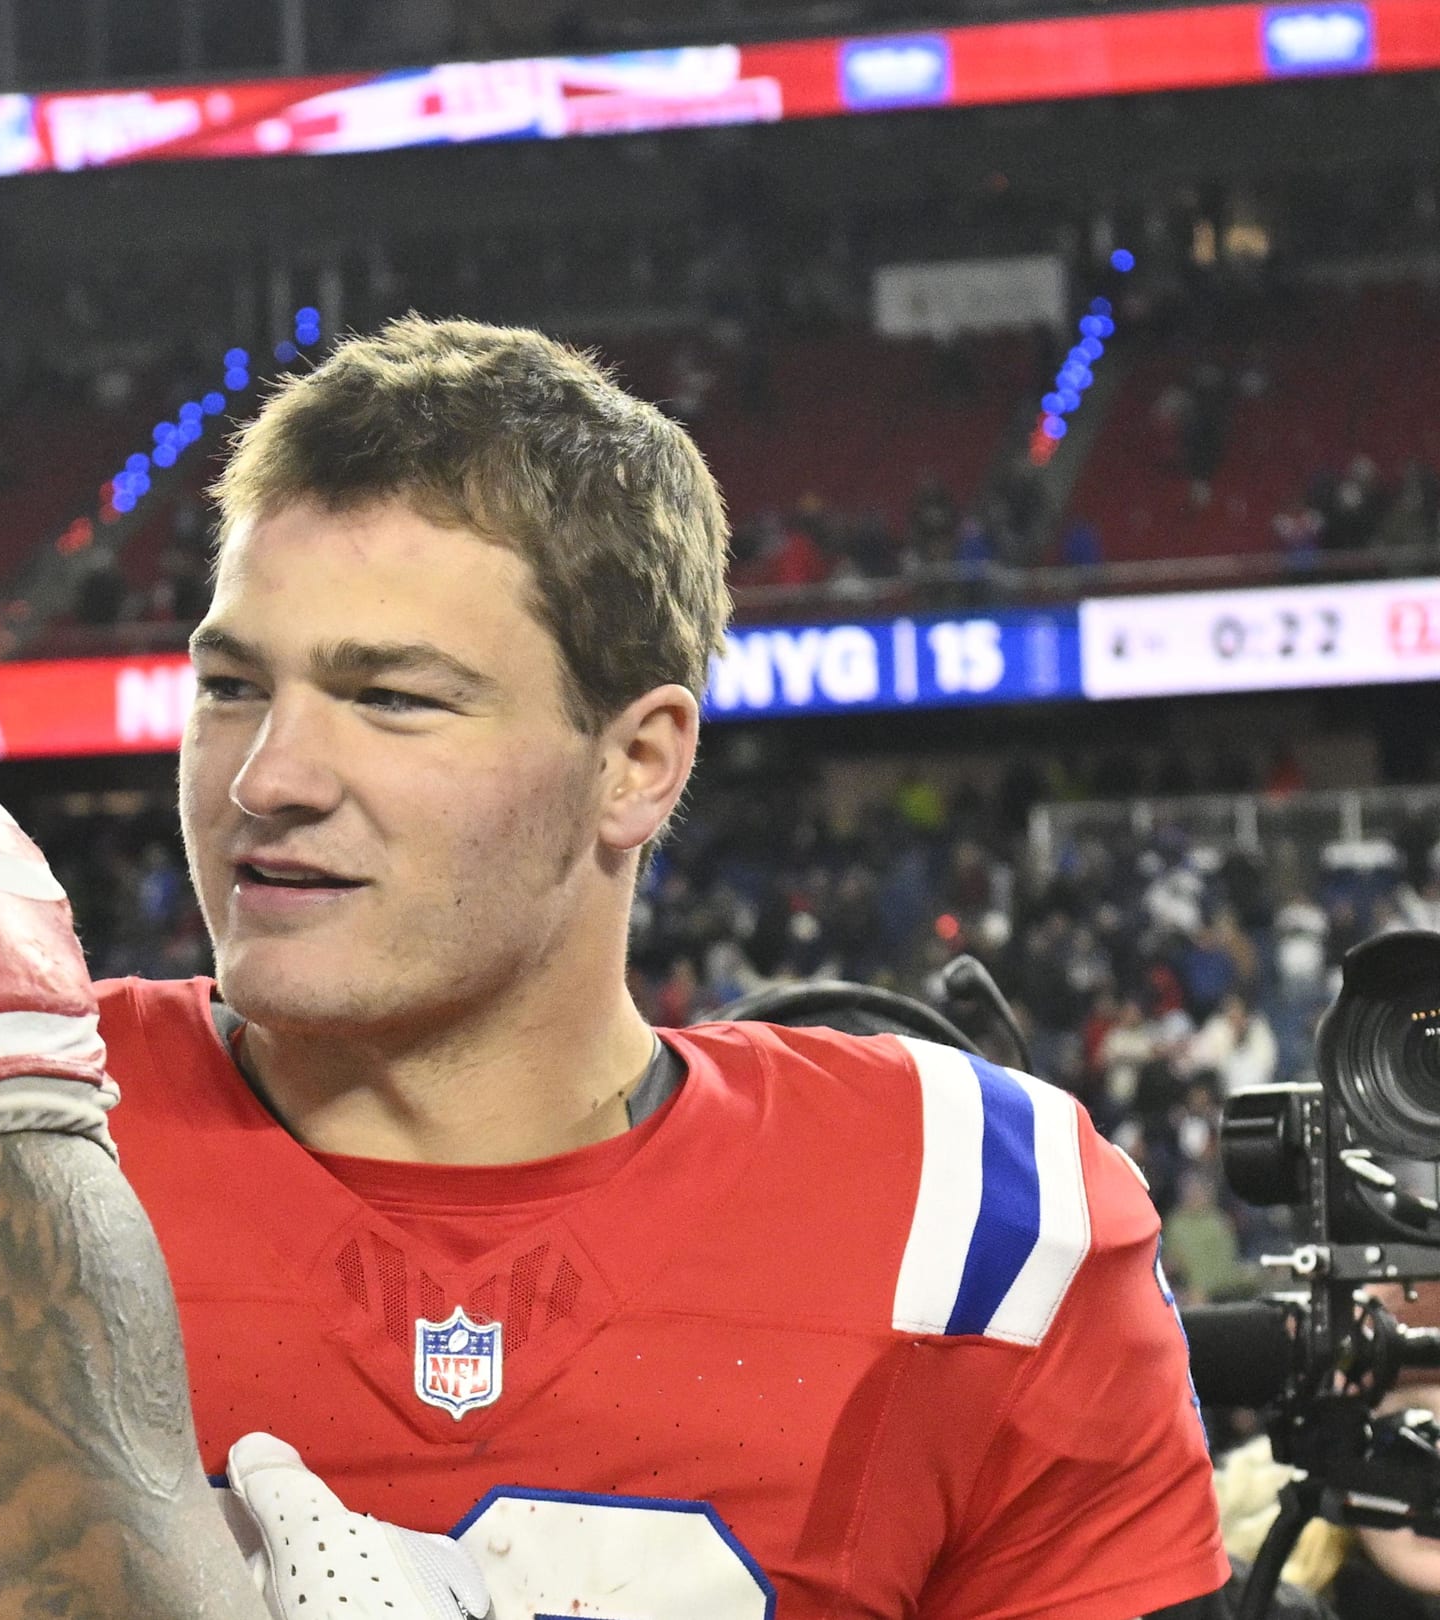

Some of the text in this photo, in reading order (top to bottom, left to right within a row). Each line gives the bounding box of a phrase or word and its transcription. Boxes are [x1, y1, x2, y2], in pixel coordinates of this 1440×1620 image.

[1210, 607, 1341, 659] 0:22
[710, 620, 1004, 708] NYG 15
[428, 1356, 488, 1398] NFL
